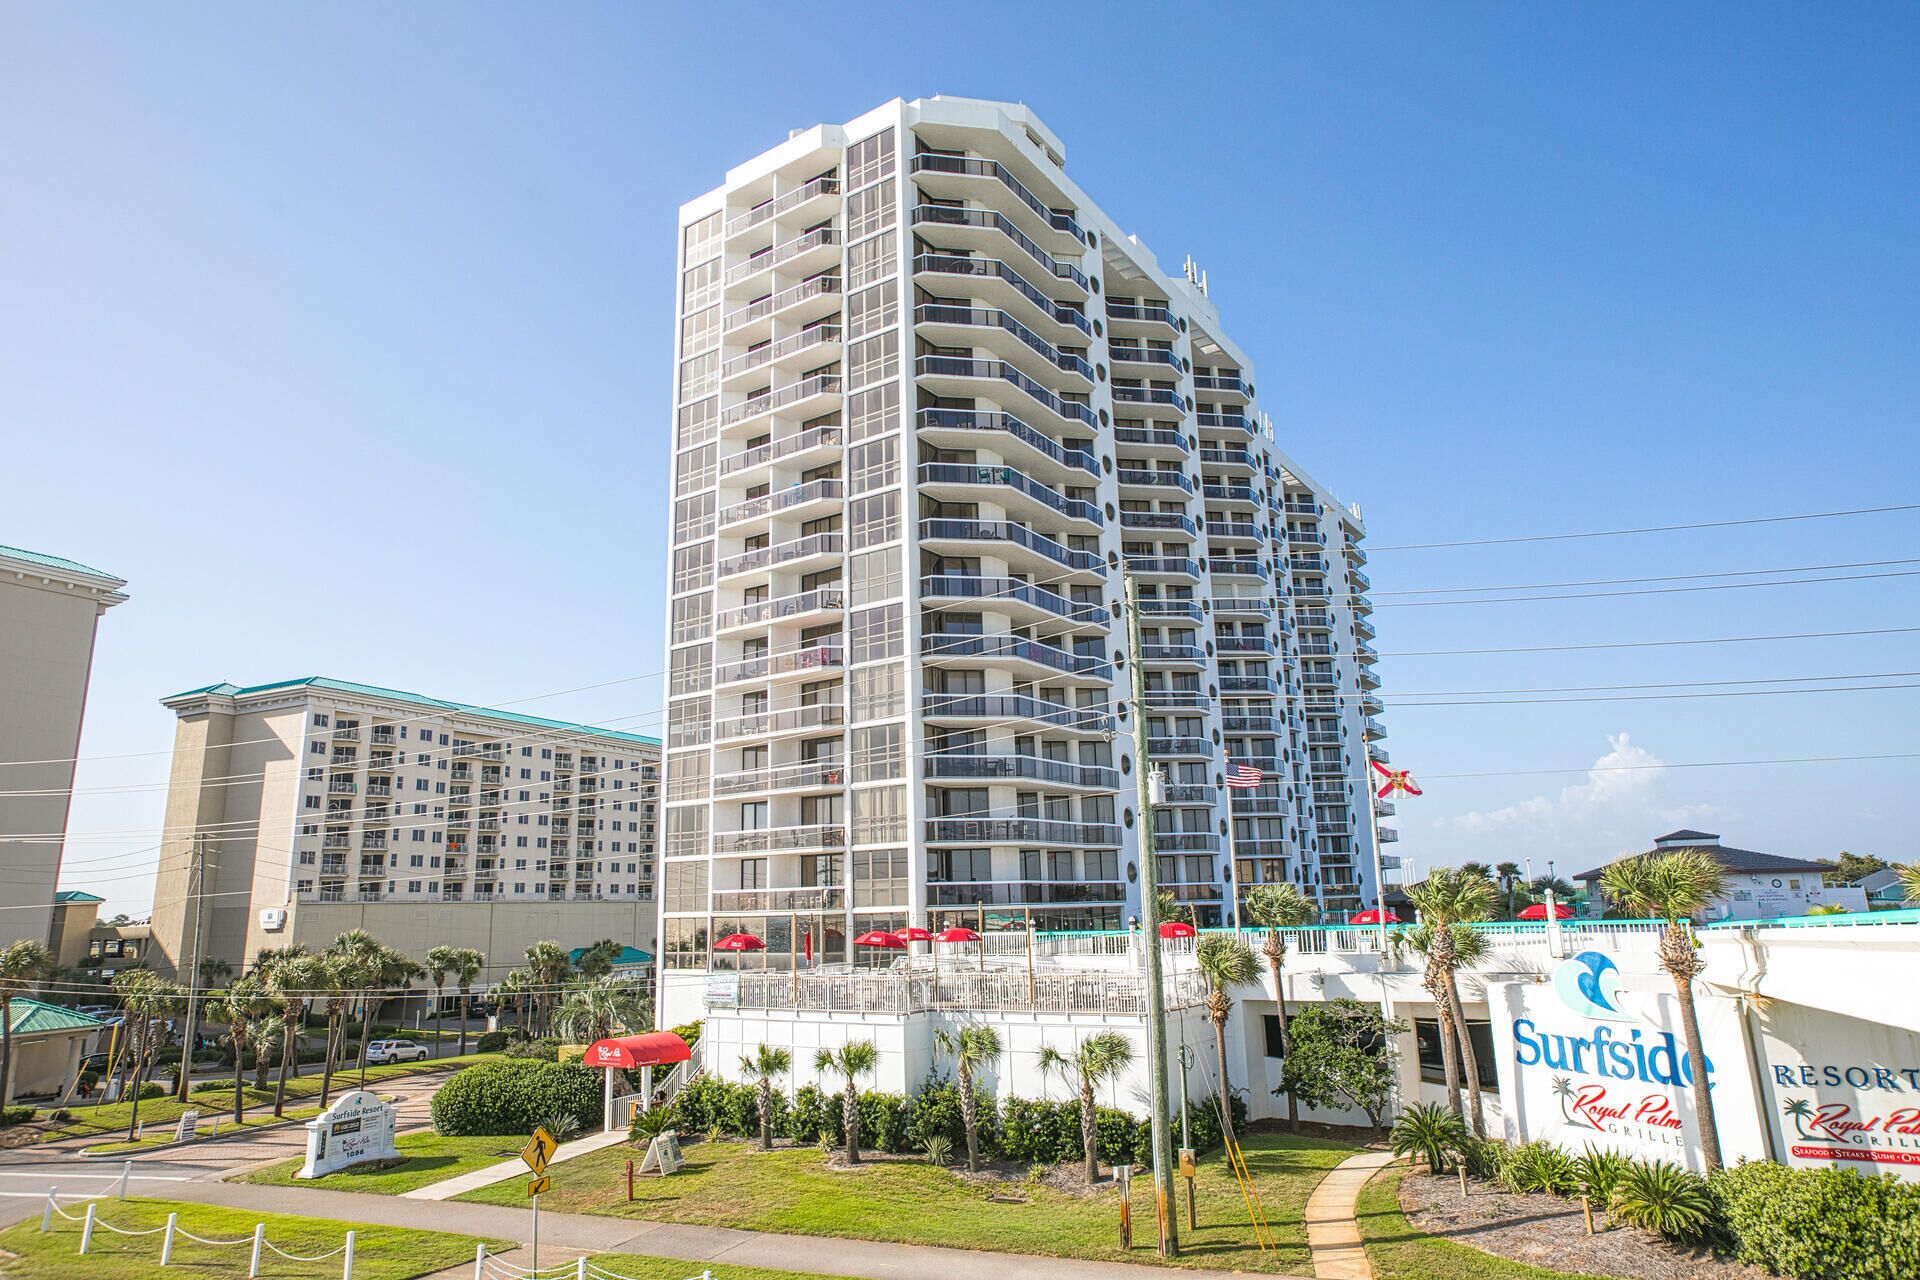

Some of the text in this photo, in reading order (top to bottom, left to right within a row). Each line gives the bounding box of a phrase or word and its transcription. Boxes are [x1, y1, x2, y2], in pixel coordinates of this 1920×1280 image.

[1771, 1064, 1920, 1091] RESORT
[332, 1105, 383, 1121] Surfside Resort
[1573, 1084, 1684, 1132] Royal Palm
[1608, 1123, 1684, 1147] GRILLE
[1809, 1103, 1881, 1143] Royal
